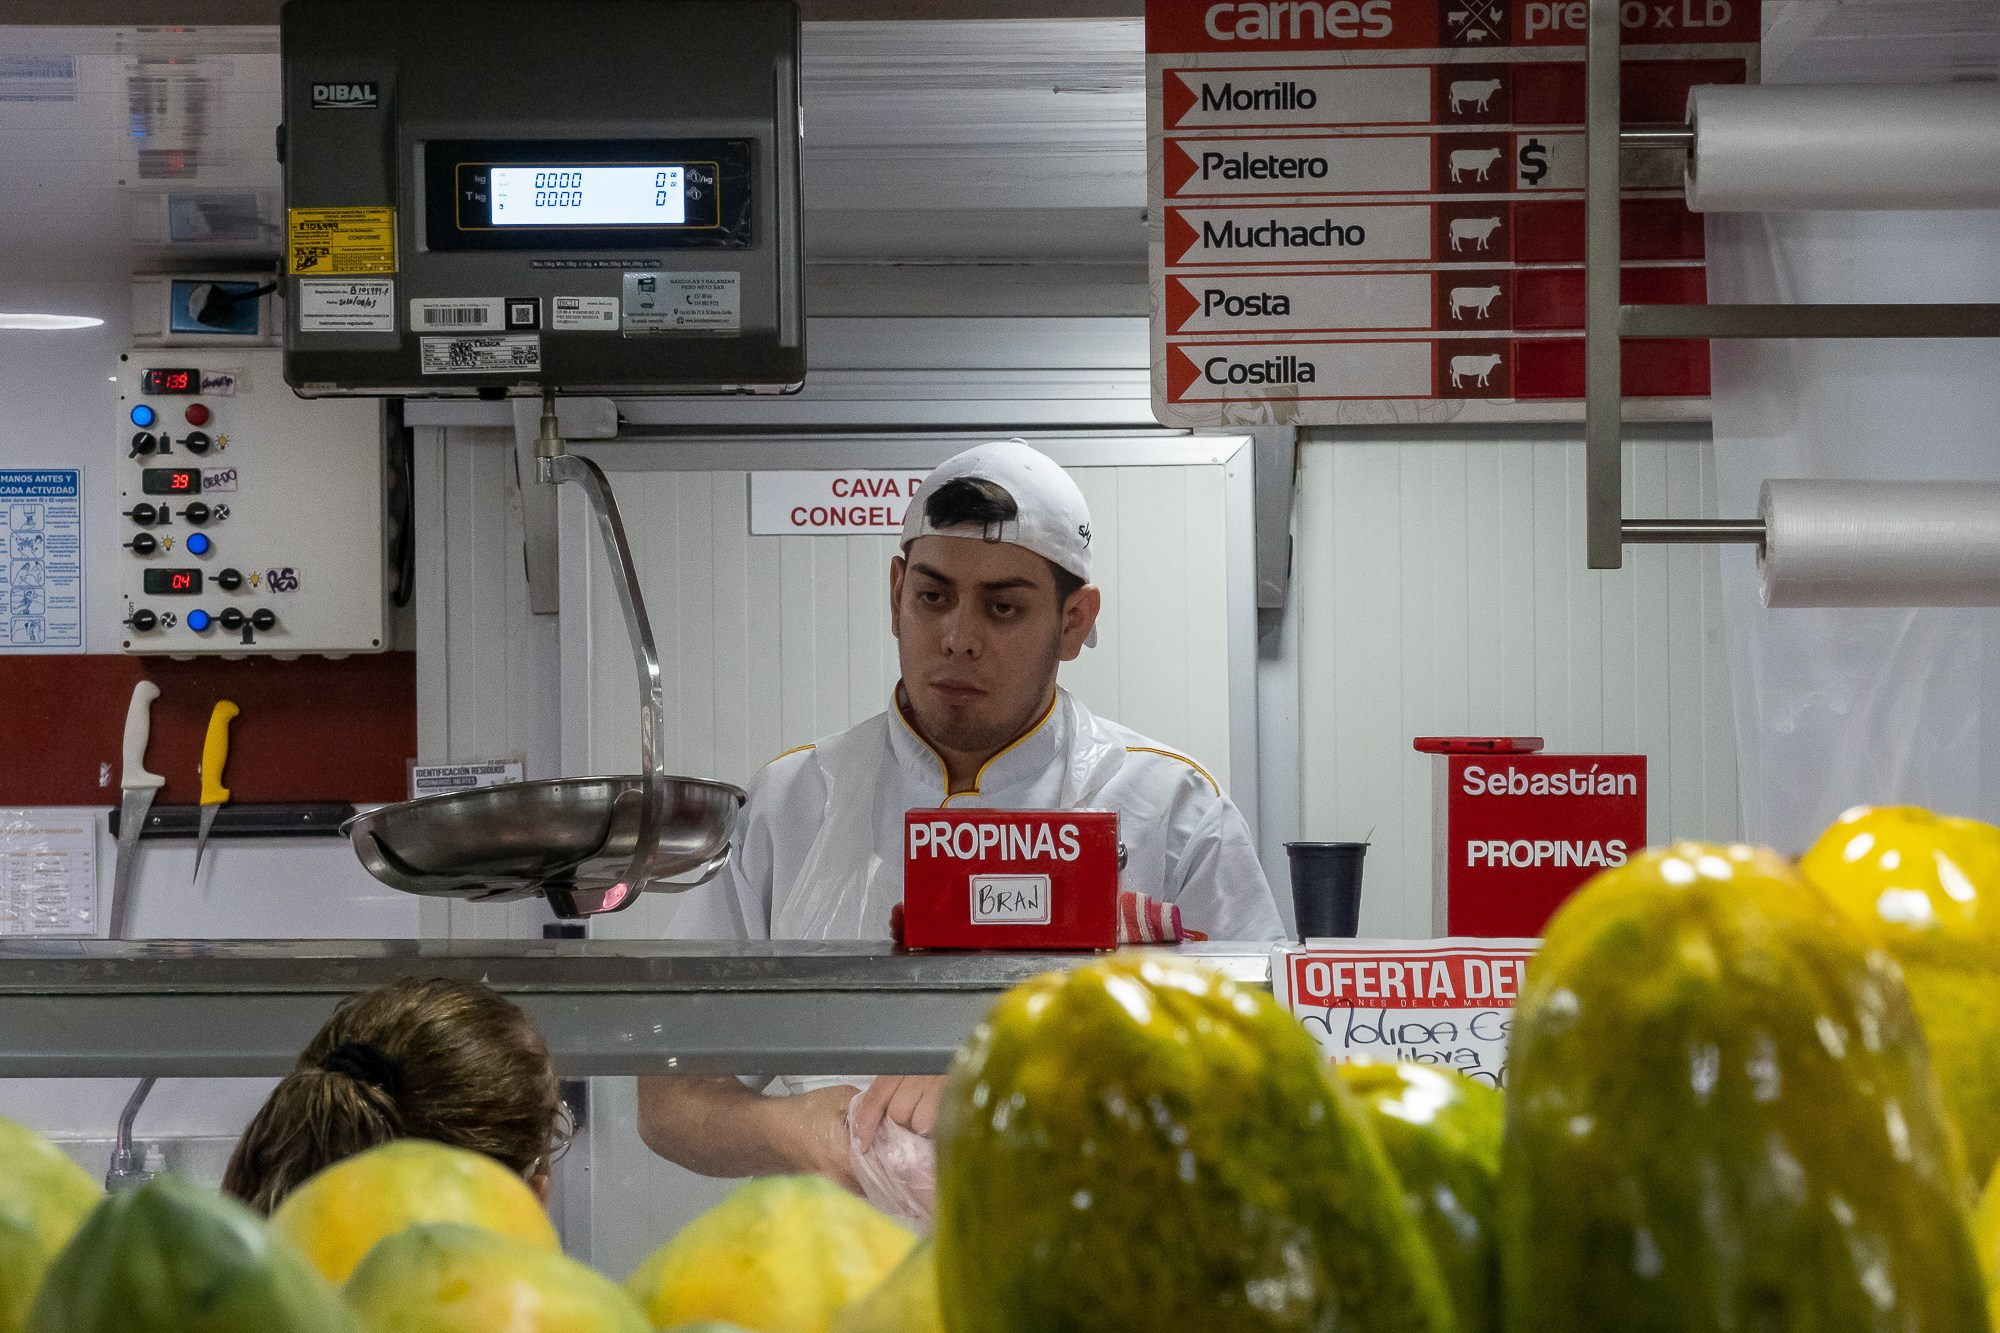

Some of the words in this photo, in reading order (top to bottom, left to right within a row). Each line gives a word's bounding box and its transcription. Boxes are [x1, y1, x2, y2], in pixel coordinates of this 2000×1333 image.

[1204, 0, 1393, 41] carnes
[1525, 1, 1647, 40] preo
[1654, 6, 1675, 28] x
[313, 85, 377, 100] DIBAL
[1202, 81, 1317, 111] Morrillo
[1202, 151, 1329, 181] Paletero
[1518, 138, 1548, 186] $
[474, 175, 486, 185] kg
[535, 172, 582, 188] 0000
[656, 172, 667, 188] 0
[474, 193, 487, 203] kg
[535, 191, 582, 207] 0000
[656, 191, 667, 207] 0
[1203, 218, 1366, 249] Muchacho
[1204, 289, 1291, 317] Posta
[1204, 355, 1316, 385] Costilla
[0, 475, 33, 483] MANOS
[35, 475, 63, 483] ANTES
[65, 475, 72, 483] Y
[0, 486, 23, 494] CADA
[25, 486, 75, 494] ACTIVIDAD
[832, 478, 900, 498] CAVA
[908, 478, 923, 498] D
[791, 506, 906, 527] CONGEL
[416, 766, 470, 777] IDENTIFICACIÓN
[471, 764, 505, 775] RESIDUOS
[1462, 764, 1638, 796] Sebastían
[909, 822, 1080, 861] PROPINAS
[1467, 839, 1627, 867] PROPINAS
[978, 884, 1039, 915] BRAN
[1305, 960, 1456, 999] OFERTA
[1400, 999, 1418, 1007] DE
[1431, 999, 1450, 1007] LA
